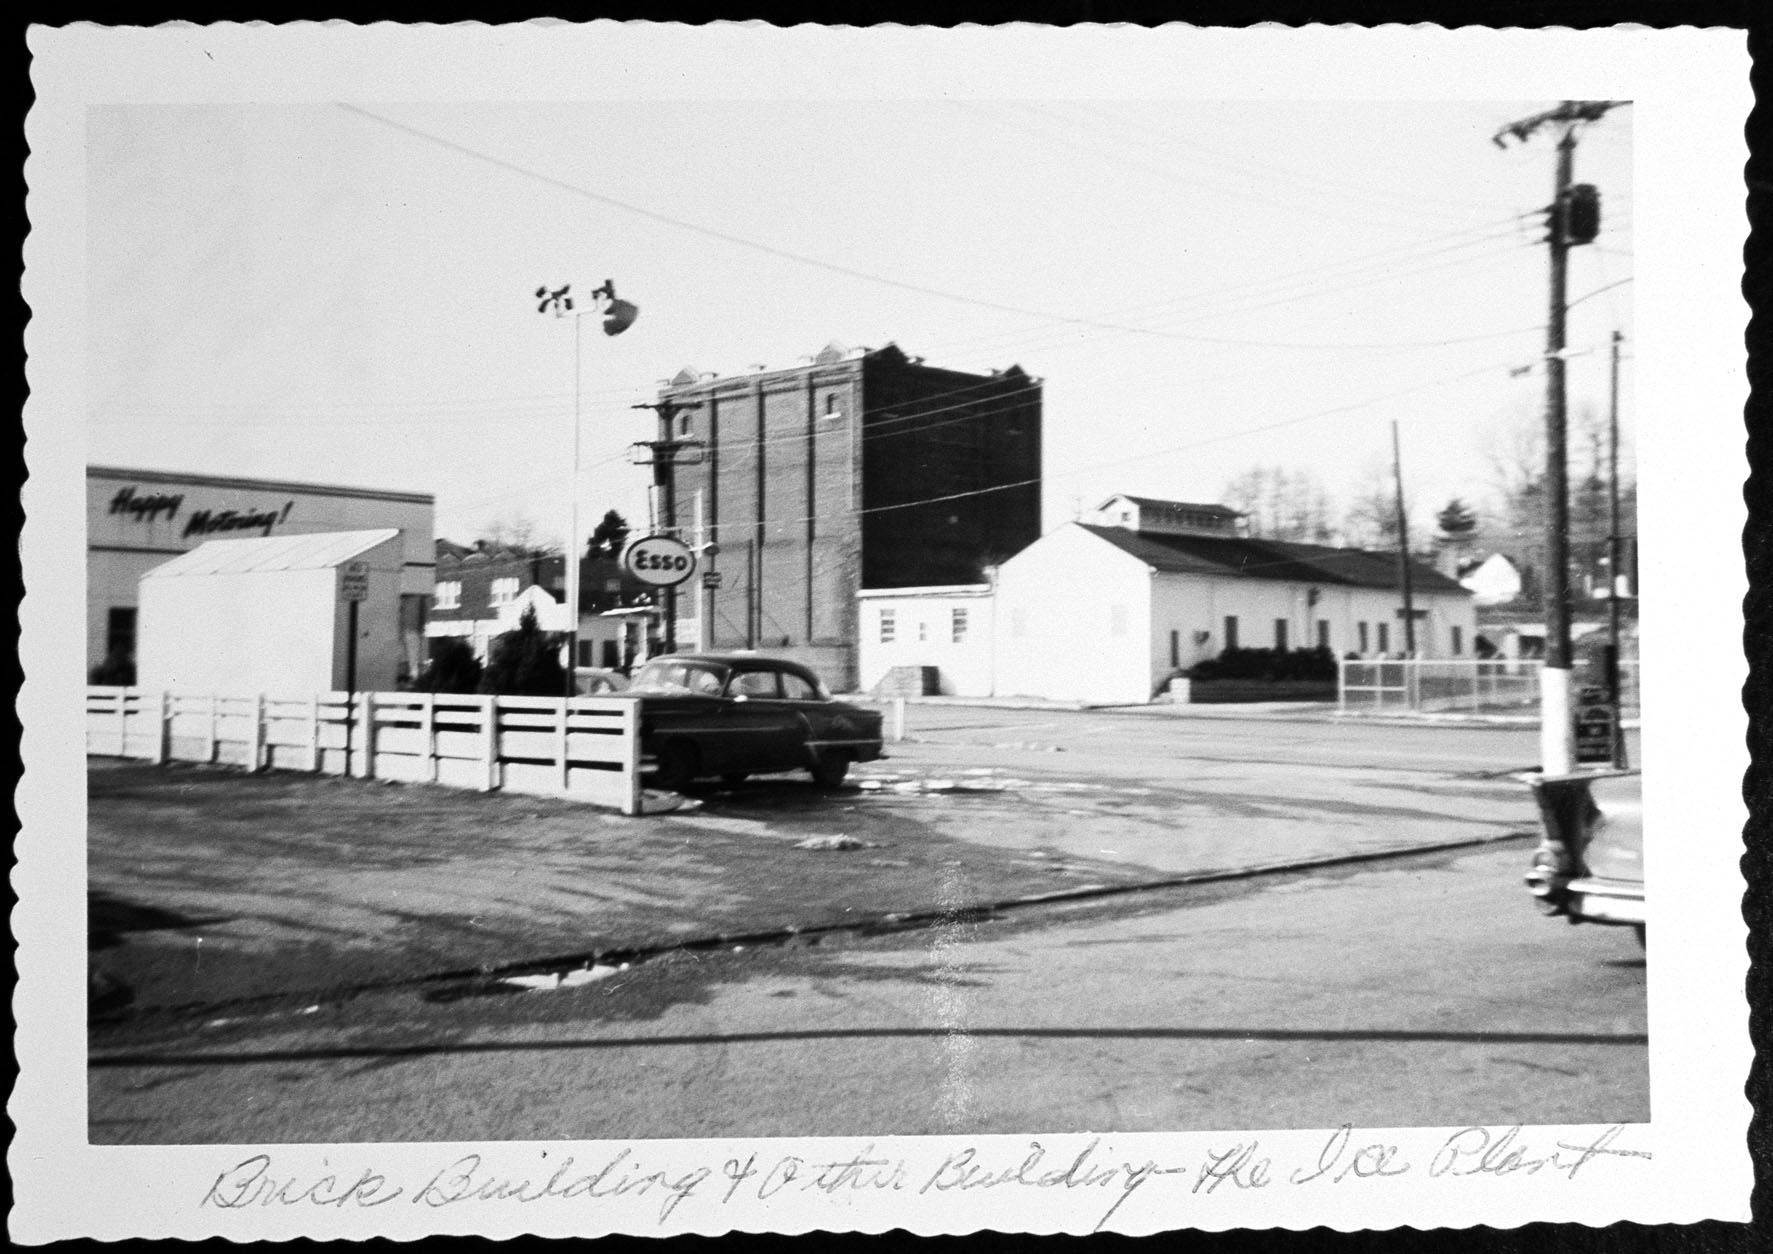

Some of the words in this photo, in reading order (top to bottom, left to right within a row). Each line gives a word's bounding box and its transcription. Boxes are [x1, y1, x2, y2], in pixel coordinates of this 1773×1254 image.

[109, 486, 185, 522] Happy
[182, 500, 294, 538] Motoring!
[635, 549, 687, 571] Esso
[200, 1154, 403, 1208] Brick
[412, 1147, 712, 1225] Building
[758, 1144, 905, 1200] Other
[1290, 1123, 1410, 1184] Ice
[1429, 1123, 1652, 1180] Plant
